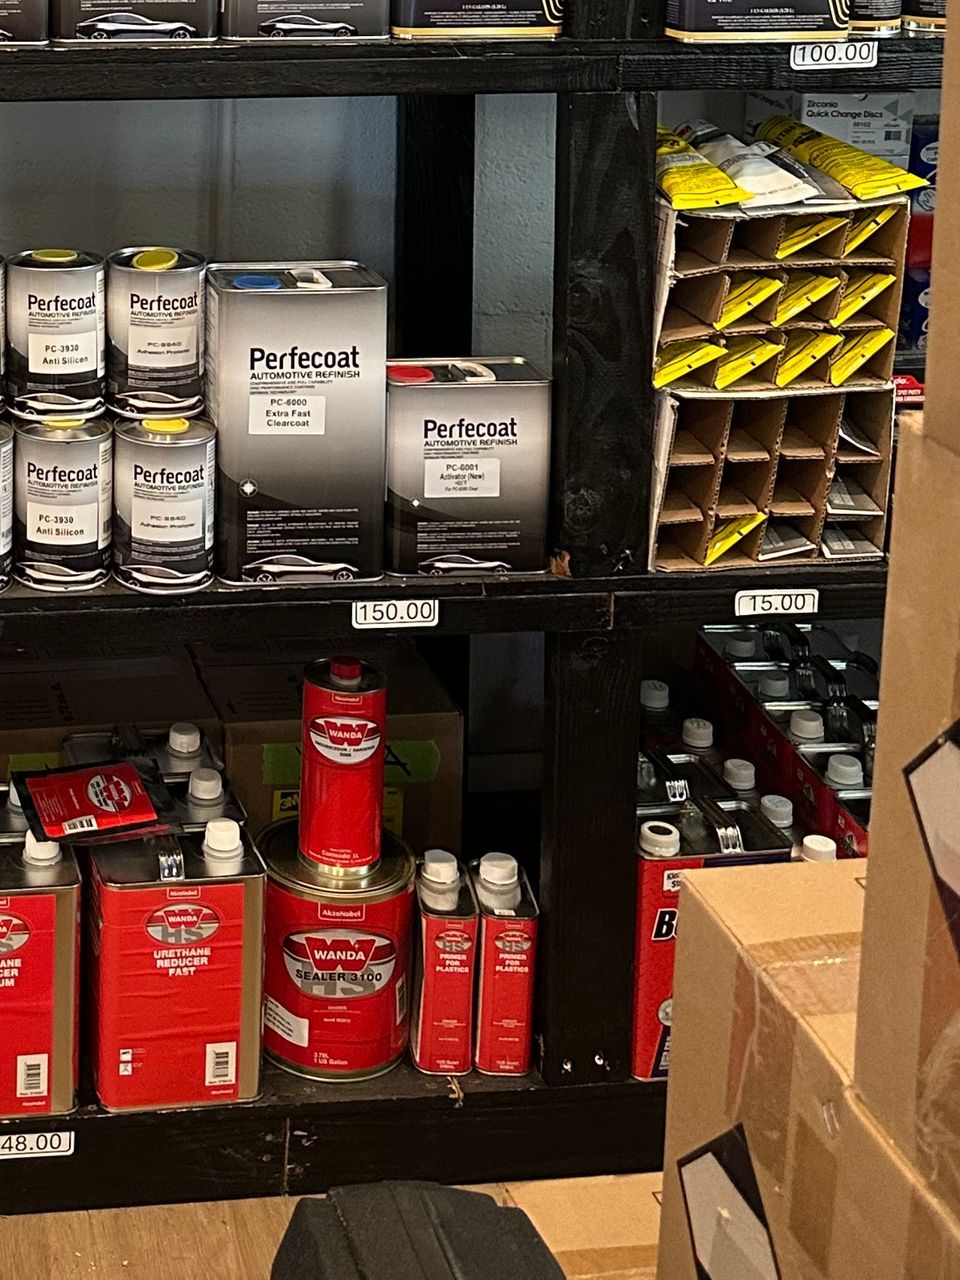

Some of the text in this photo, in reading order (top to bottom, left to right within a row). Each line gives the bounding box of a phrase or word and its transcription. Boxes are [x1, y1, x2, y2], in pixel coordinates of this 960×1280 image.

[798, 44, 871, 63] 100.00
[807, 100, 838, 108] Zirconia
[806, 110, 829, 118] Quick
[831, 110, 862, 119] Change
[43, 356, 89, 365] Anti Silicon
[250, 370, 360, 380] AUTOMOTIVE REFINISH
[265, 409, 311, 418] Extra Fast
[267, 419, 310, 427] Clearcoat
[36, 527, 85, 536] Anti Silicon
[749, 594, 807, 612] 15.00
[359, 601, 433, 622] 150.00
[322, 909, 361, 918] AkzoNobel
[167, 915, 198, 923] WANDA
[153, 947, 211, 959] URETHANE
[440, 953, 467, 961] PRIMER
[499, 953, 527, 961] PRIMER
[156, 957, 208, 968] REDUCER
[446, 959, 461, 967] FOR
[505, 959, 521, 967] FOR
[168, 967, 196, 977] FAST
[495, 965, 529, 973] PLASTICS
[295, 969, 383, 982] SEALER 3100
[0, 1133, 63, 1153] 48.00
